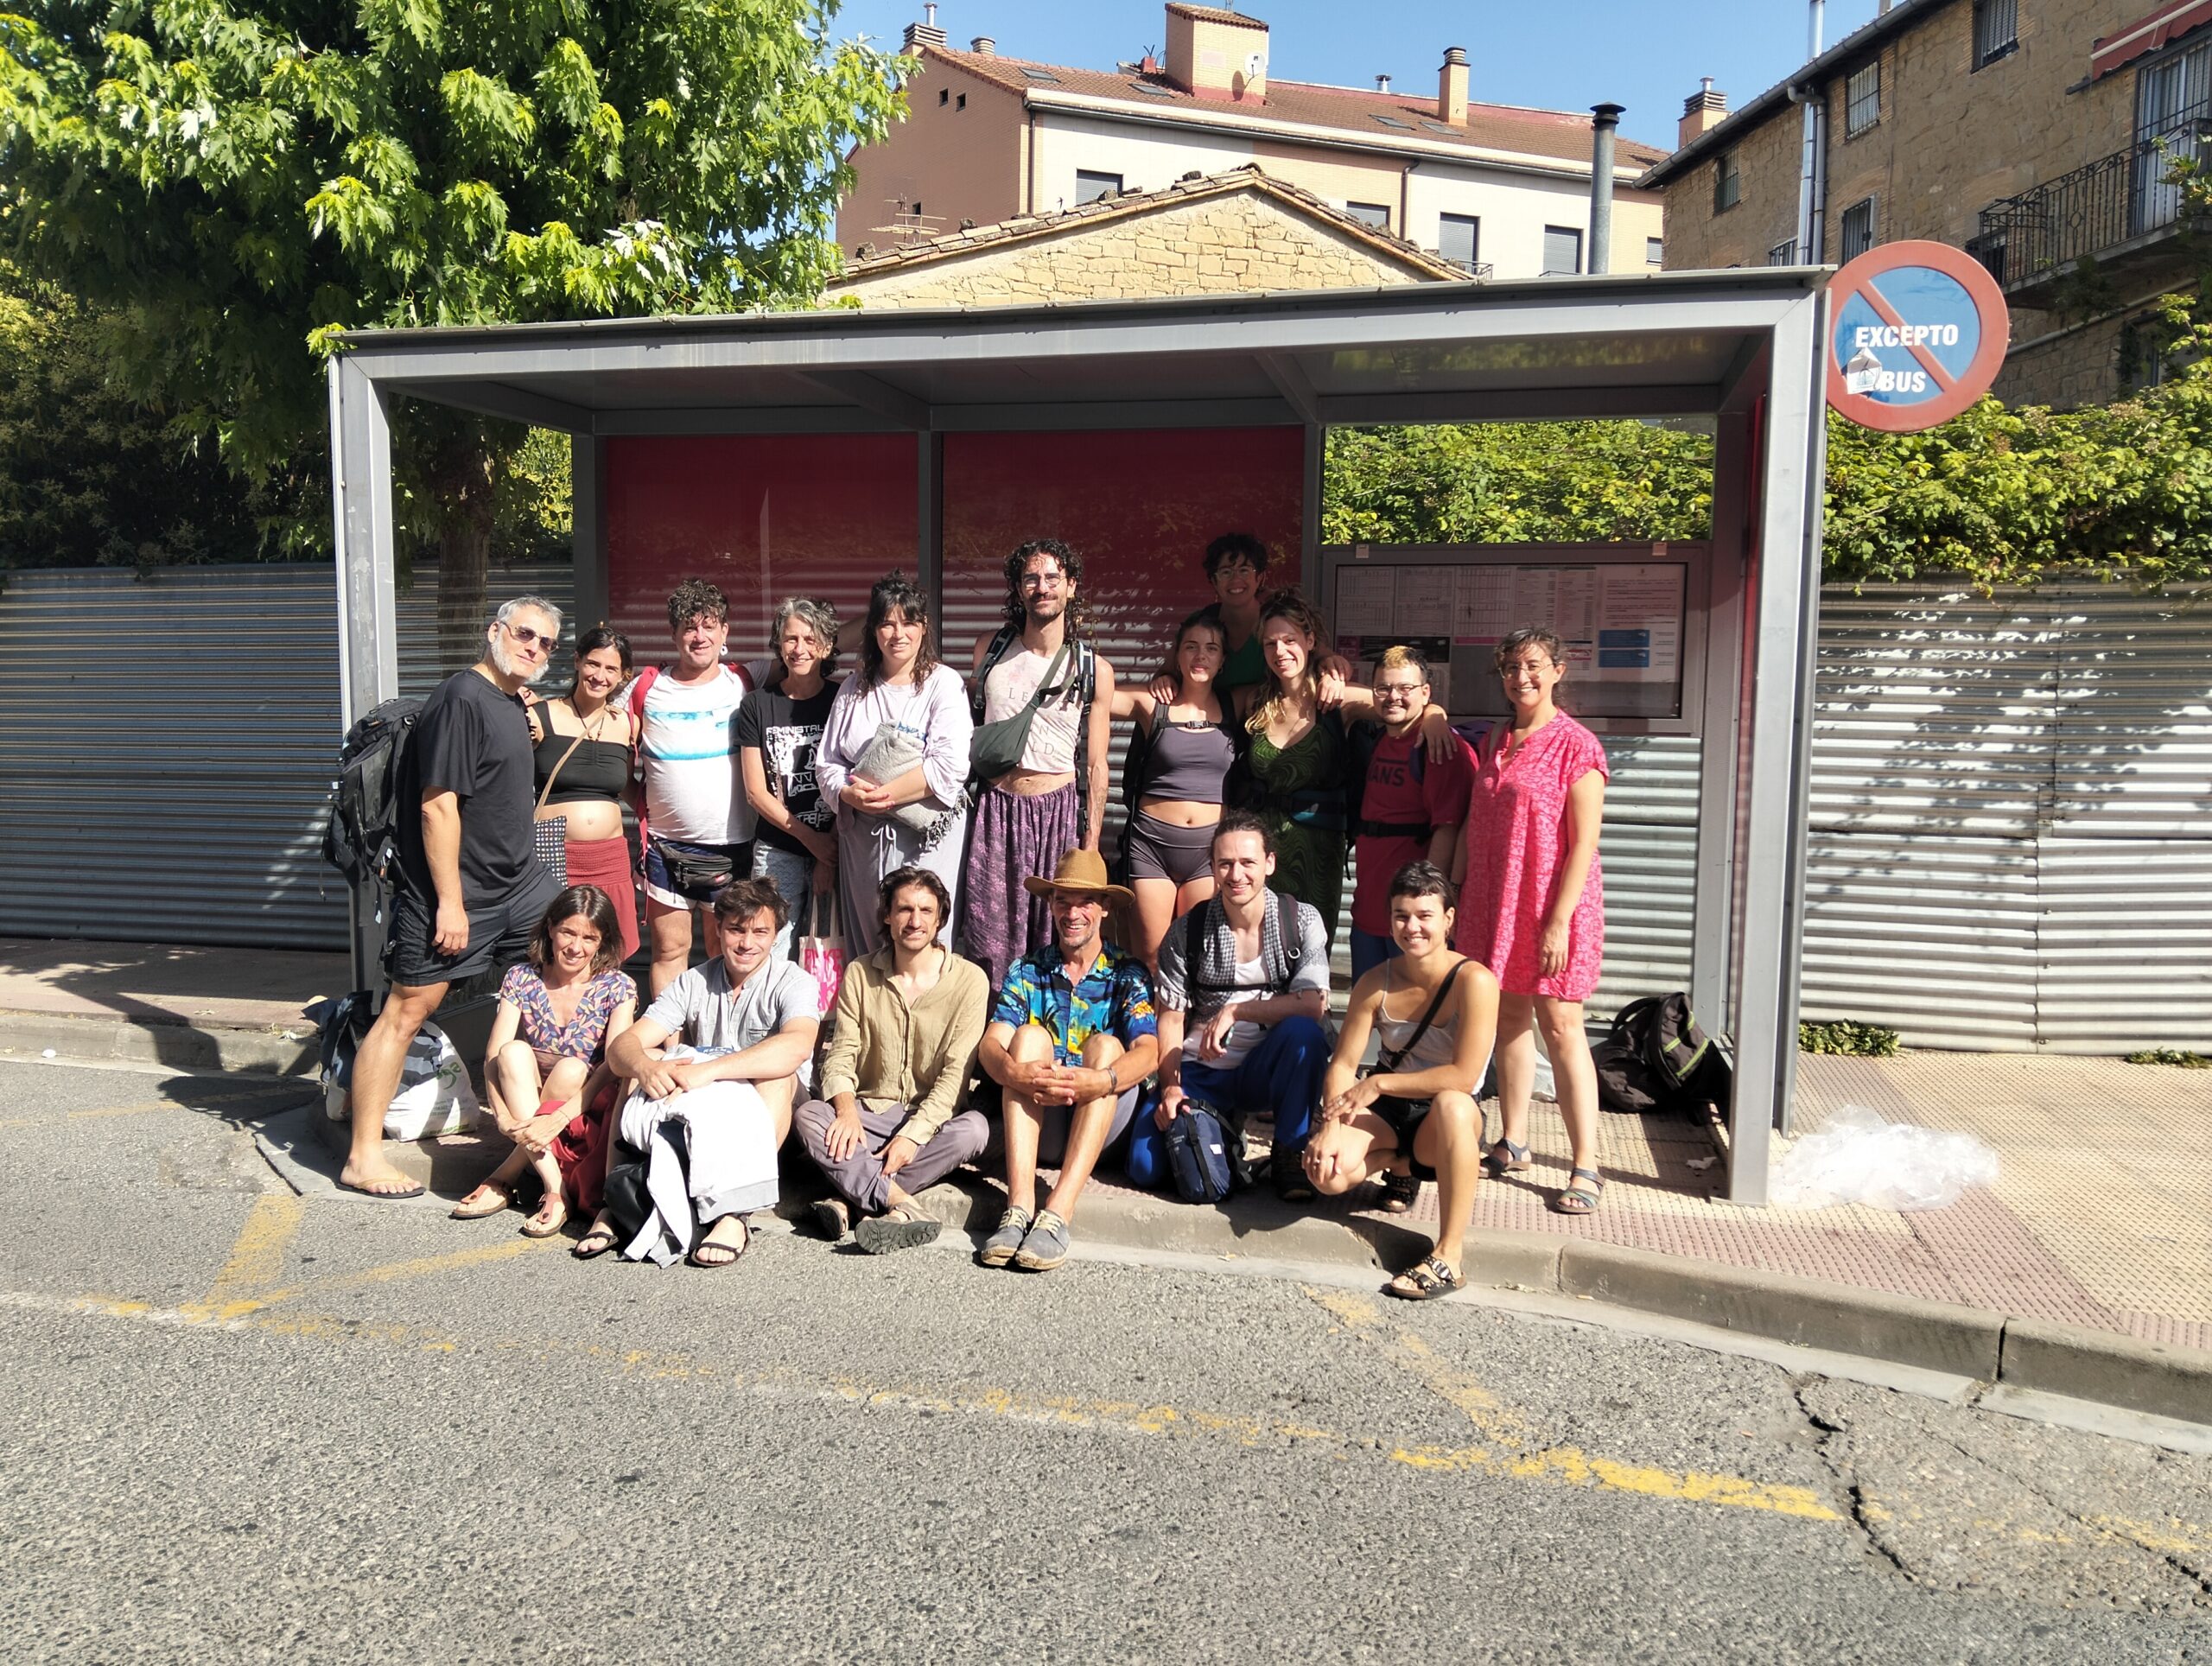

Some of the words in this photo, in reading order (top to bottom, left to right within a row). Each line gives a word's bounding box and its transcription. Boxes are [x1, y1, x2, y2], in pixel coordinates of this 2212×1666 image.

[1855, 324, 1959, 347] EXCEPTO
[1880, 371, 1926, 392] BUS
[1368, 764, 1406, 787] ANS
